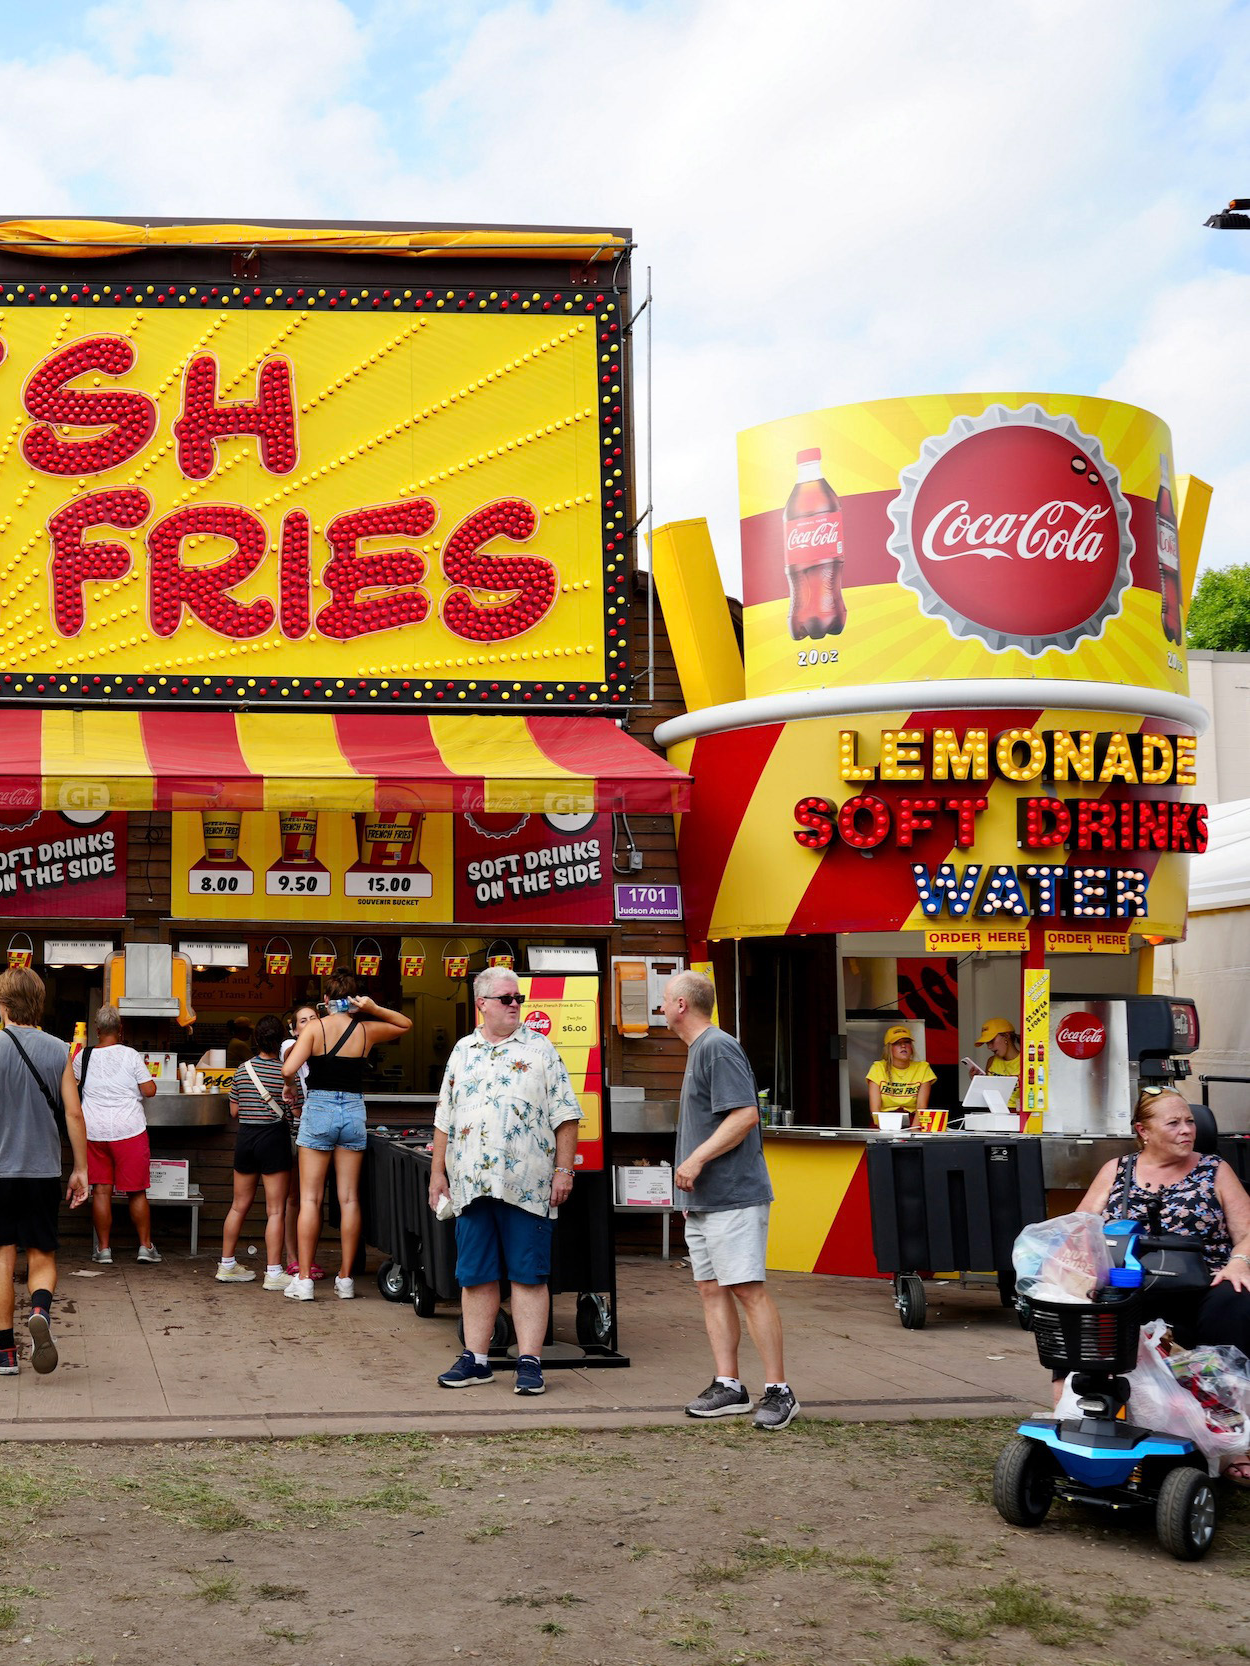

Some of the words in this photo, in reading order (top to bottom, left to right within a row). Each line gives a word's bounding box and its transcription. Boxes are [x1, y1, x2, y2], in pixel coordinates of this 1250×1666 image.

[787, 521, 840, 551] Coca-Cola
[921, 499, 1112, 563] Coca-Cola
[48, 485, 560, 644] FRIES
[839, 727, 1197, 786] LEMONADE
[367, 829, 393, 840] FRENCH
[394, 829, 412, 840] FRIES
[793, 795, 989, 850] SOFT
[1017, 797, 1209, 854] DRINKS
[38, 831, 115, 863] DRINKS
[20, 862, 65, 888] THE
[67, 852, 116, 879] SIDE
[467, 854, 520, 881] SOFT
[524, 839, 601, 871] DRINKS
[200, 876, 239, 892] 8.00
[278, 875, 318, 892] 9.50
[367, 877, 411, 892] 15.00
[476, 880, 505, 902] ON
[507, 871, 551, 895] THE
[555, 860, 602, 887] SIDE
[910, 863, 1148, 919] WATER
[628, 888, 666, 902] 1701
[618, 907, 648, 916] Judson
[648, 907, 678, 916] Avenue
[928, 932, 982, 945] ORDER
[987, 931, 1027, 945] HERE
[1047, 933, 1092, 946] ORDER
[1095, 934, 1127, 946] HERE
[562, 1024, 587, 1032] $6.00
[1057, 1027, 1105, 1043] Coca-Cola
